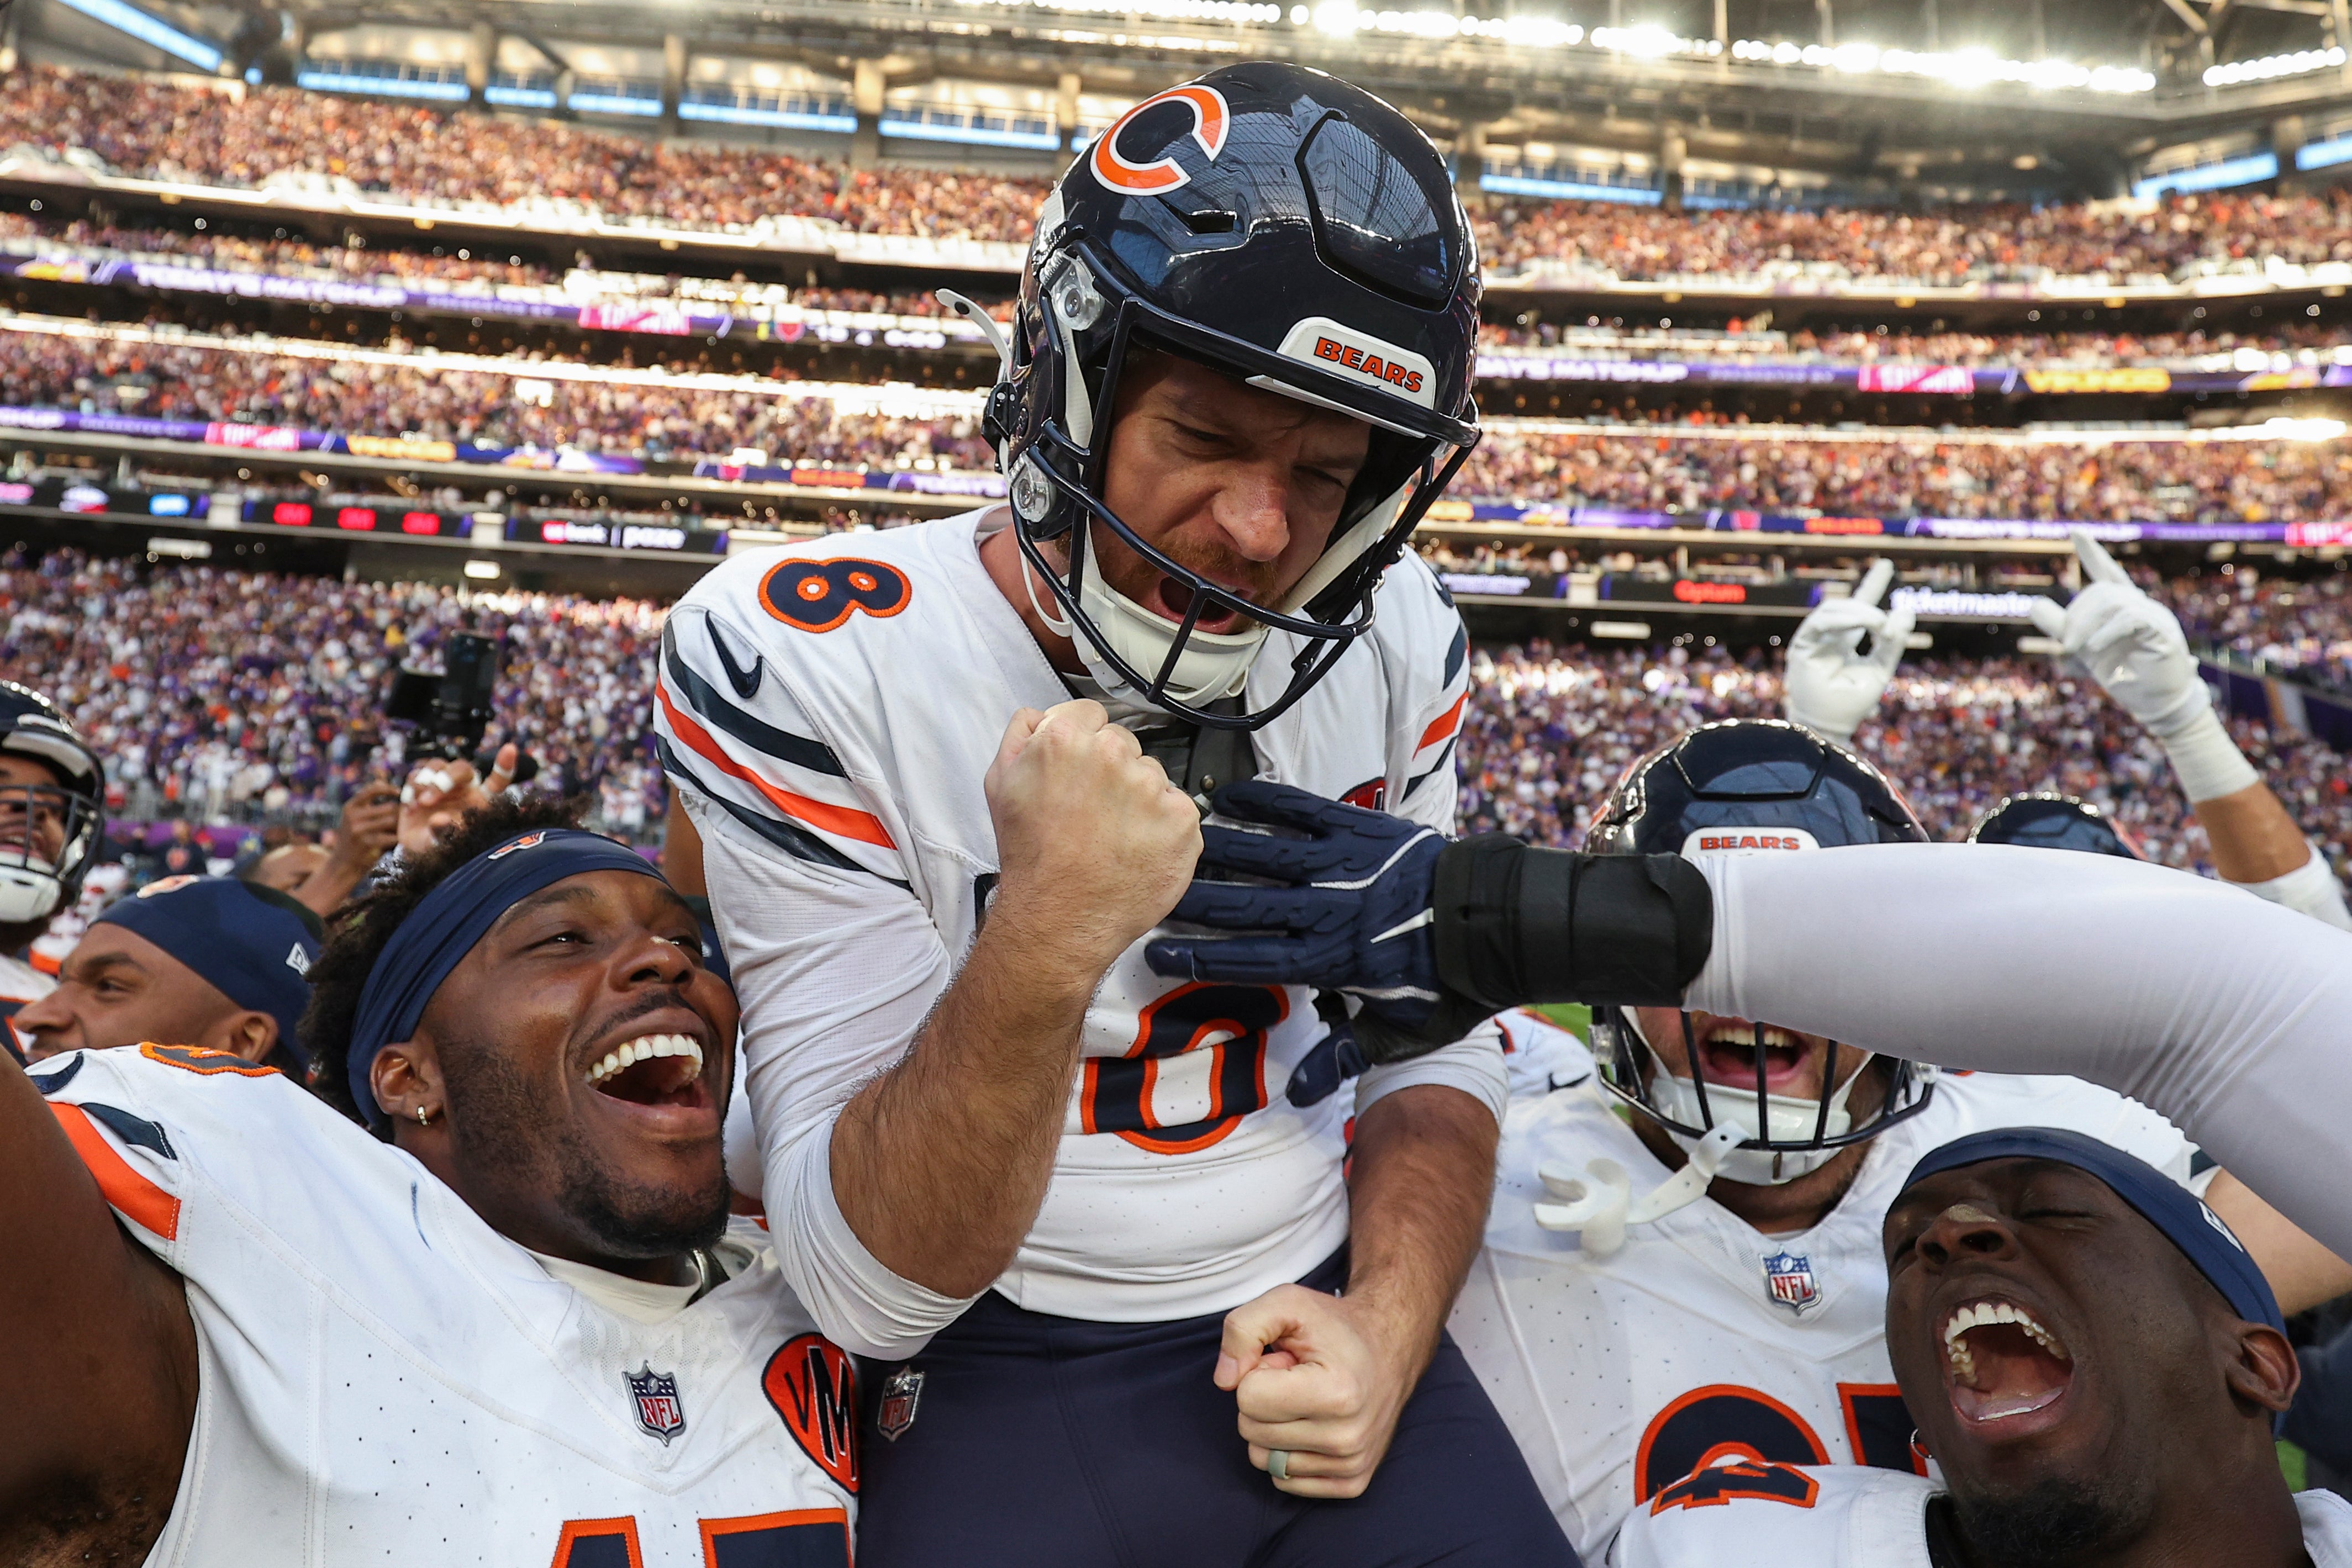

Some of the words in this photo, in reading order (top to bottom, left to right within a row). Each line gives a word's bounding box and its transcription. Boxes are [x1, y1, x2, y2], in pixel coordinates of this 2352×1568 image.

[1090, 85, 1230, 196] C
[1314, 336, 1424, 393] BEARS
[757, 557, 912, 633] 8
[1701, 836, 1800, 851] BEARS
[1772, 1275, 1813, 1301] NFL
[640, 1398, 681, 1429] NFL
